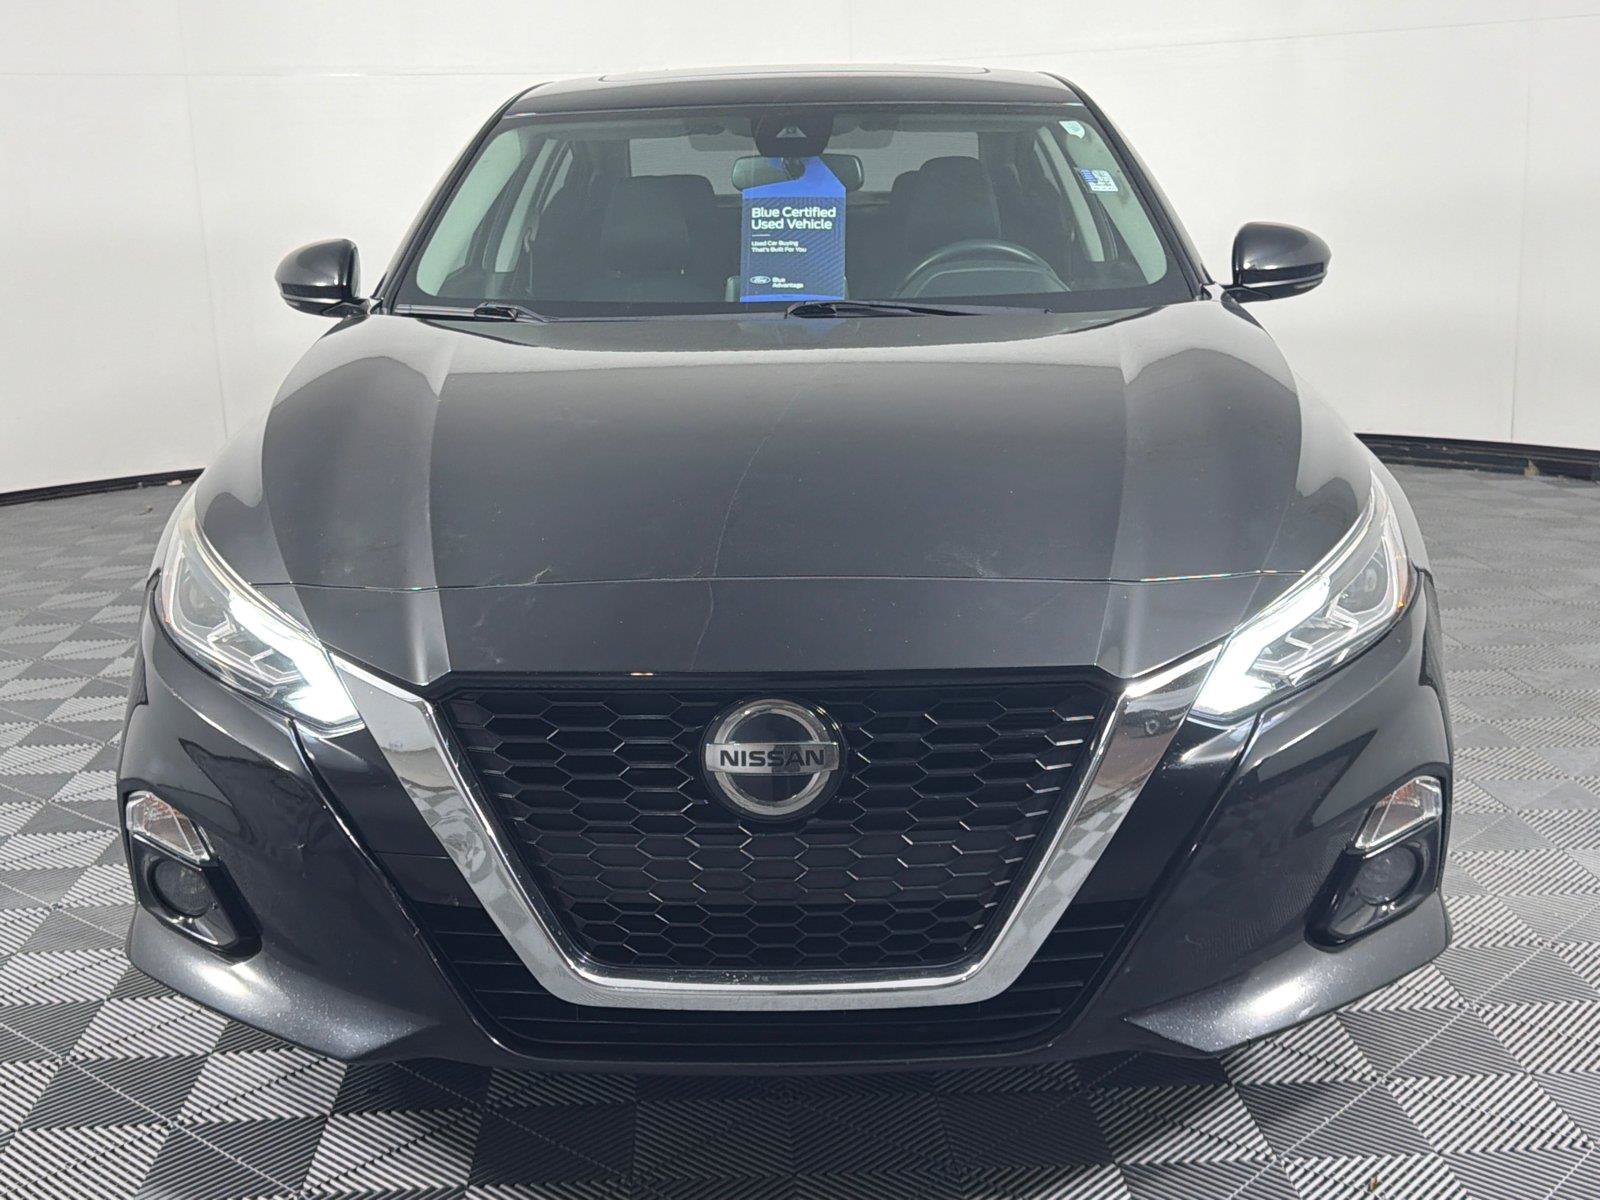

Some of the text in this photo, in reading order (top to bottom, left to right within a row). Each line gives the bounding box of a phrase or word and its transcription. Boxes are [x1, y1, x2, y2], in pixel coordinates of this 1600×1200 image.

[752, 206, 837, 218] Blue Certified
[751, 219, 832, 230] Used Vehicle
[720, 749, 824, 767] NISSAN
